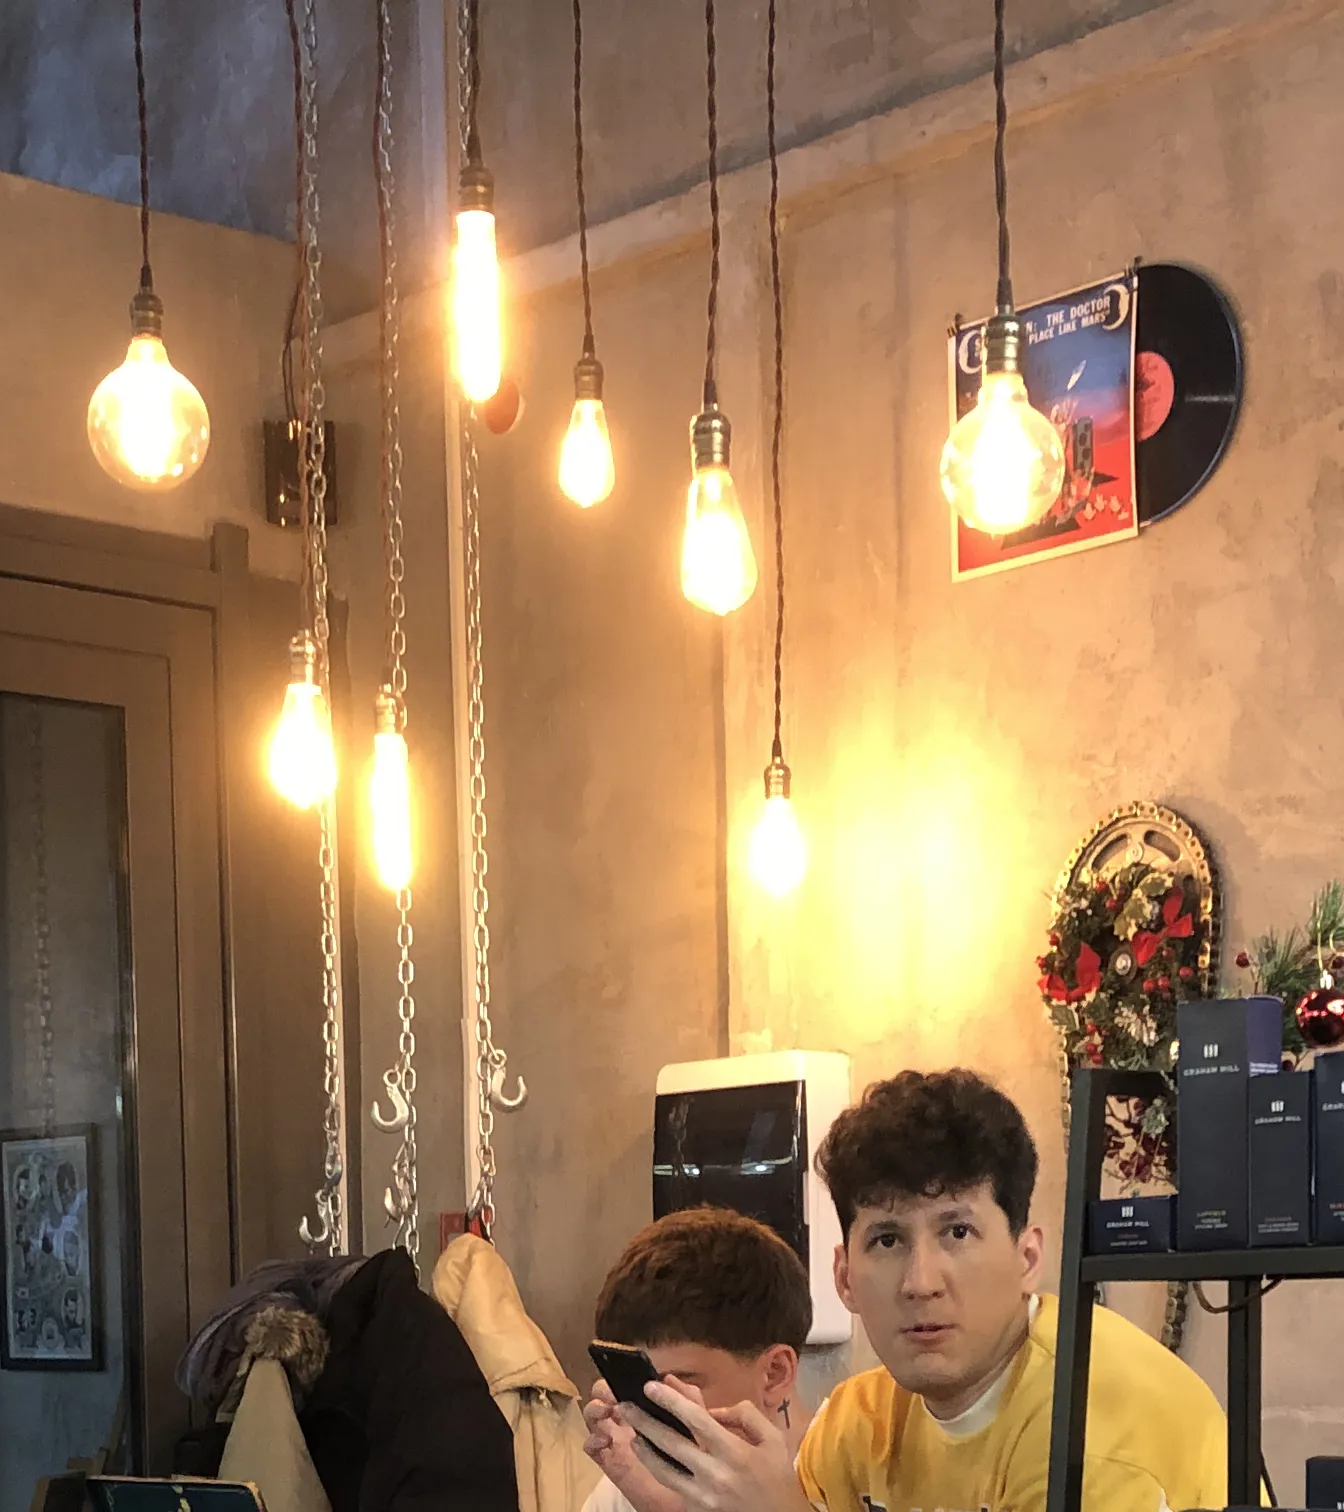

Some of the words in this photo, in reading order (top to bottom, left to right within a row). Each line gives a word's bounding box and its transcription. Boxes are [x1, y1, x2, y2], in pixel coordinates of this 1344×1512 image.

[1047, 309, 1065, 325] THE
[1070, 295, 1111, 317] DOCTOR
[1029, 327, 1054, 345] PLACE
[1058, 320, 1077, 336] LIKE
